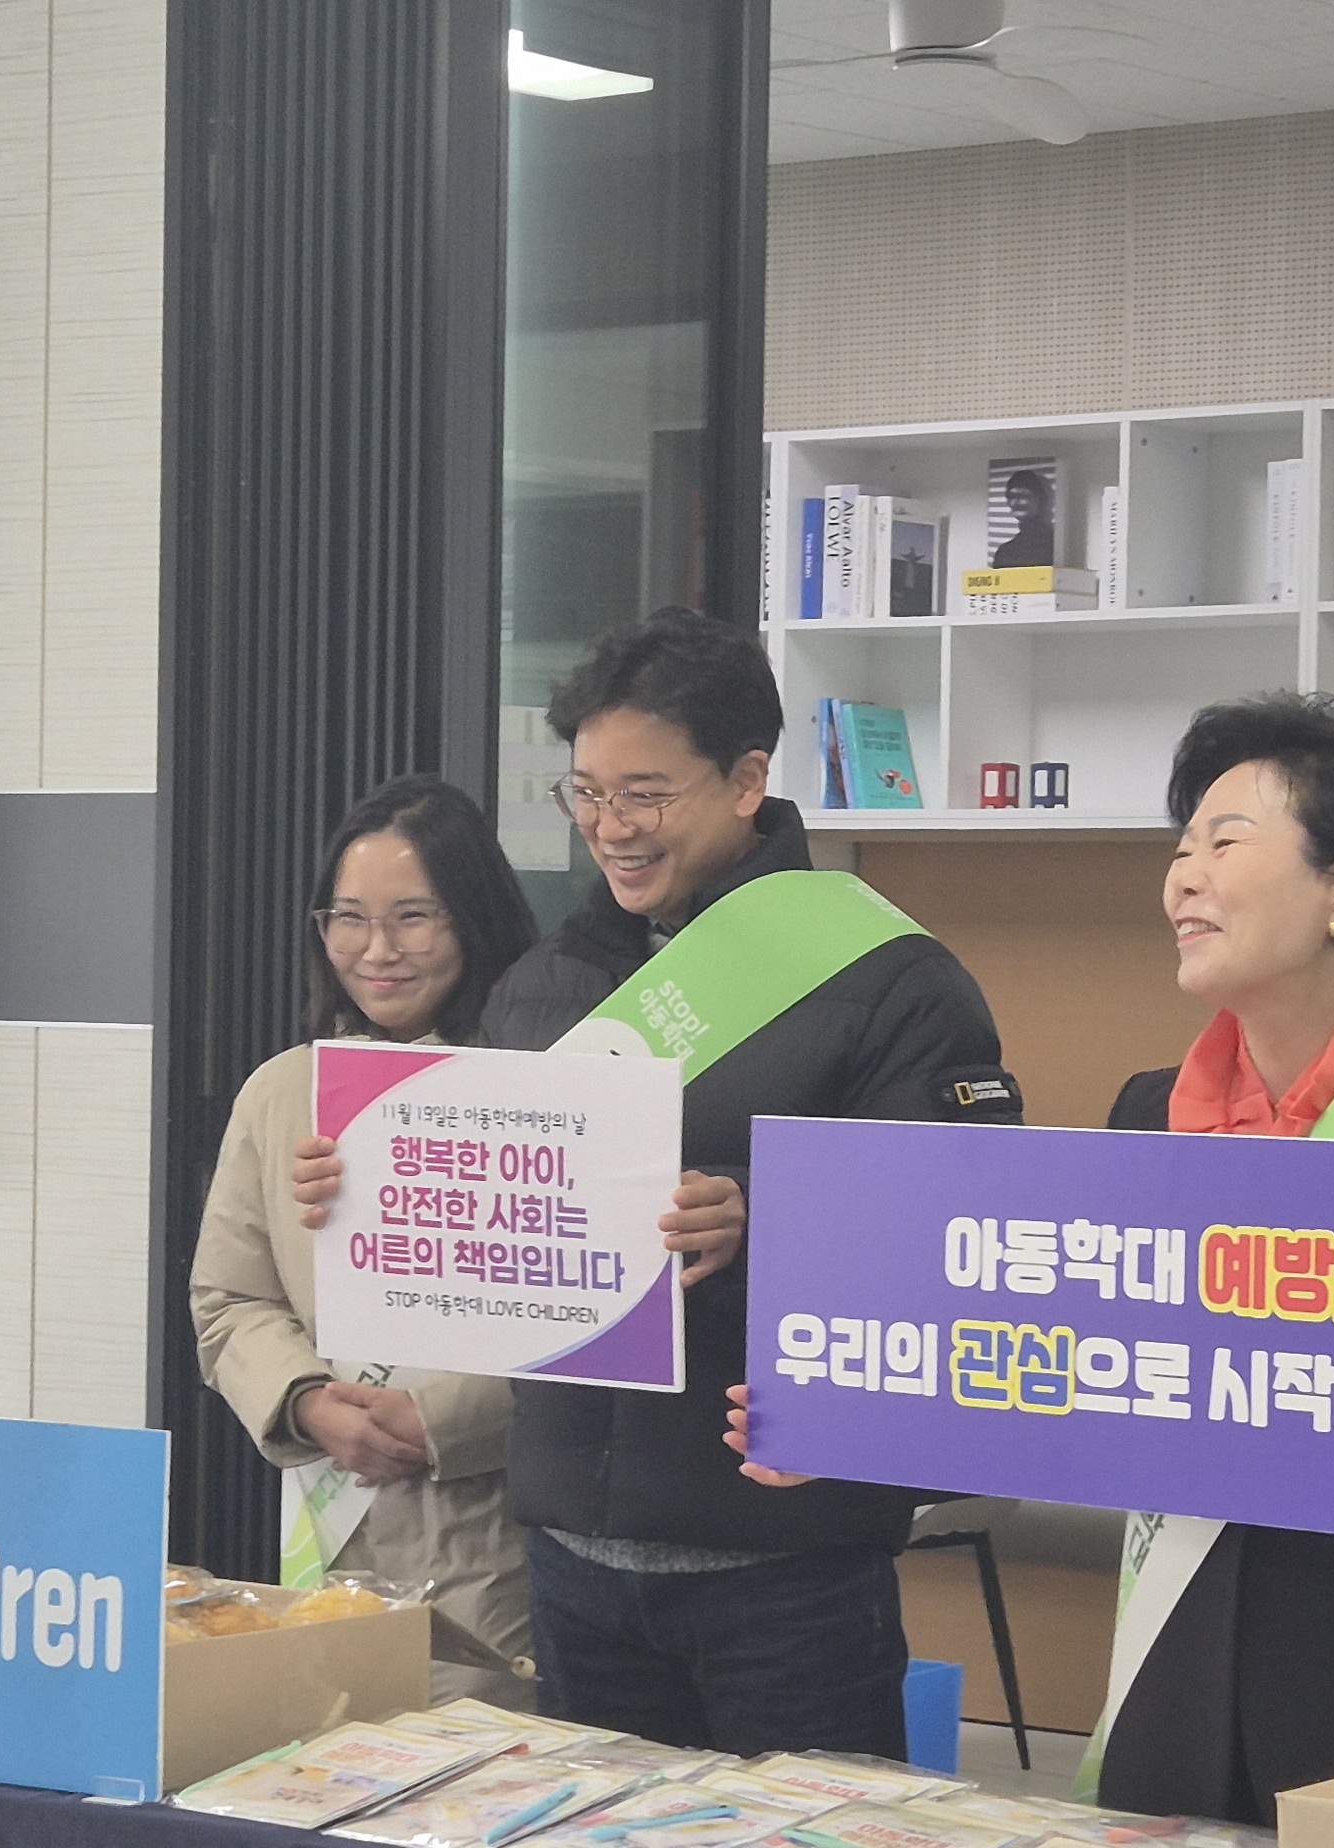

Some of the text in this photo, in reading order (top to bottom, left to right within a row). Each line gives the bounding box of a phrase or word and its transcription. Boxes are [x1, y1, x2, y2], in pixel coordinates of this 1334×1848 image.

[825, 496, 839, 561] LOEWE
[839, 500, 855, 589] Alvar Aalto
[657, 979, 712, 1040] stop!
[379, 1103, 414, 1127] 11월
[417, 1104, 460, 1128] 19일은
[571, 1112, 588, 1136] 날
[390, 1134, 575, 1190] 행복한 아이,
[378, 1184, 589, 1240] 안전한 사회는
[349, 1231, 626, 1293] 어른의 책임입니다
[943, 1216, 1186, 1306] 아동학대
[384, 1290, 599, 1325] STOP 아동학대 LOVE CHILDREN
[775, 1312, 939, 1398] 우리의
[949, 1317, 1192, 1422] 관심으로
